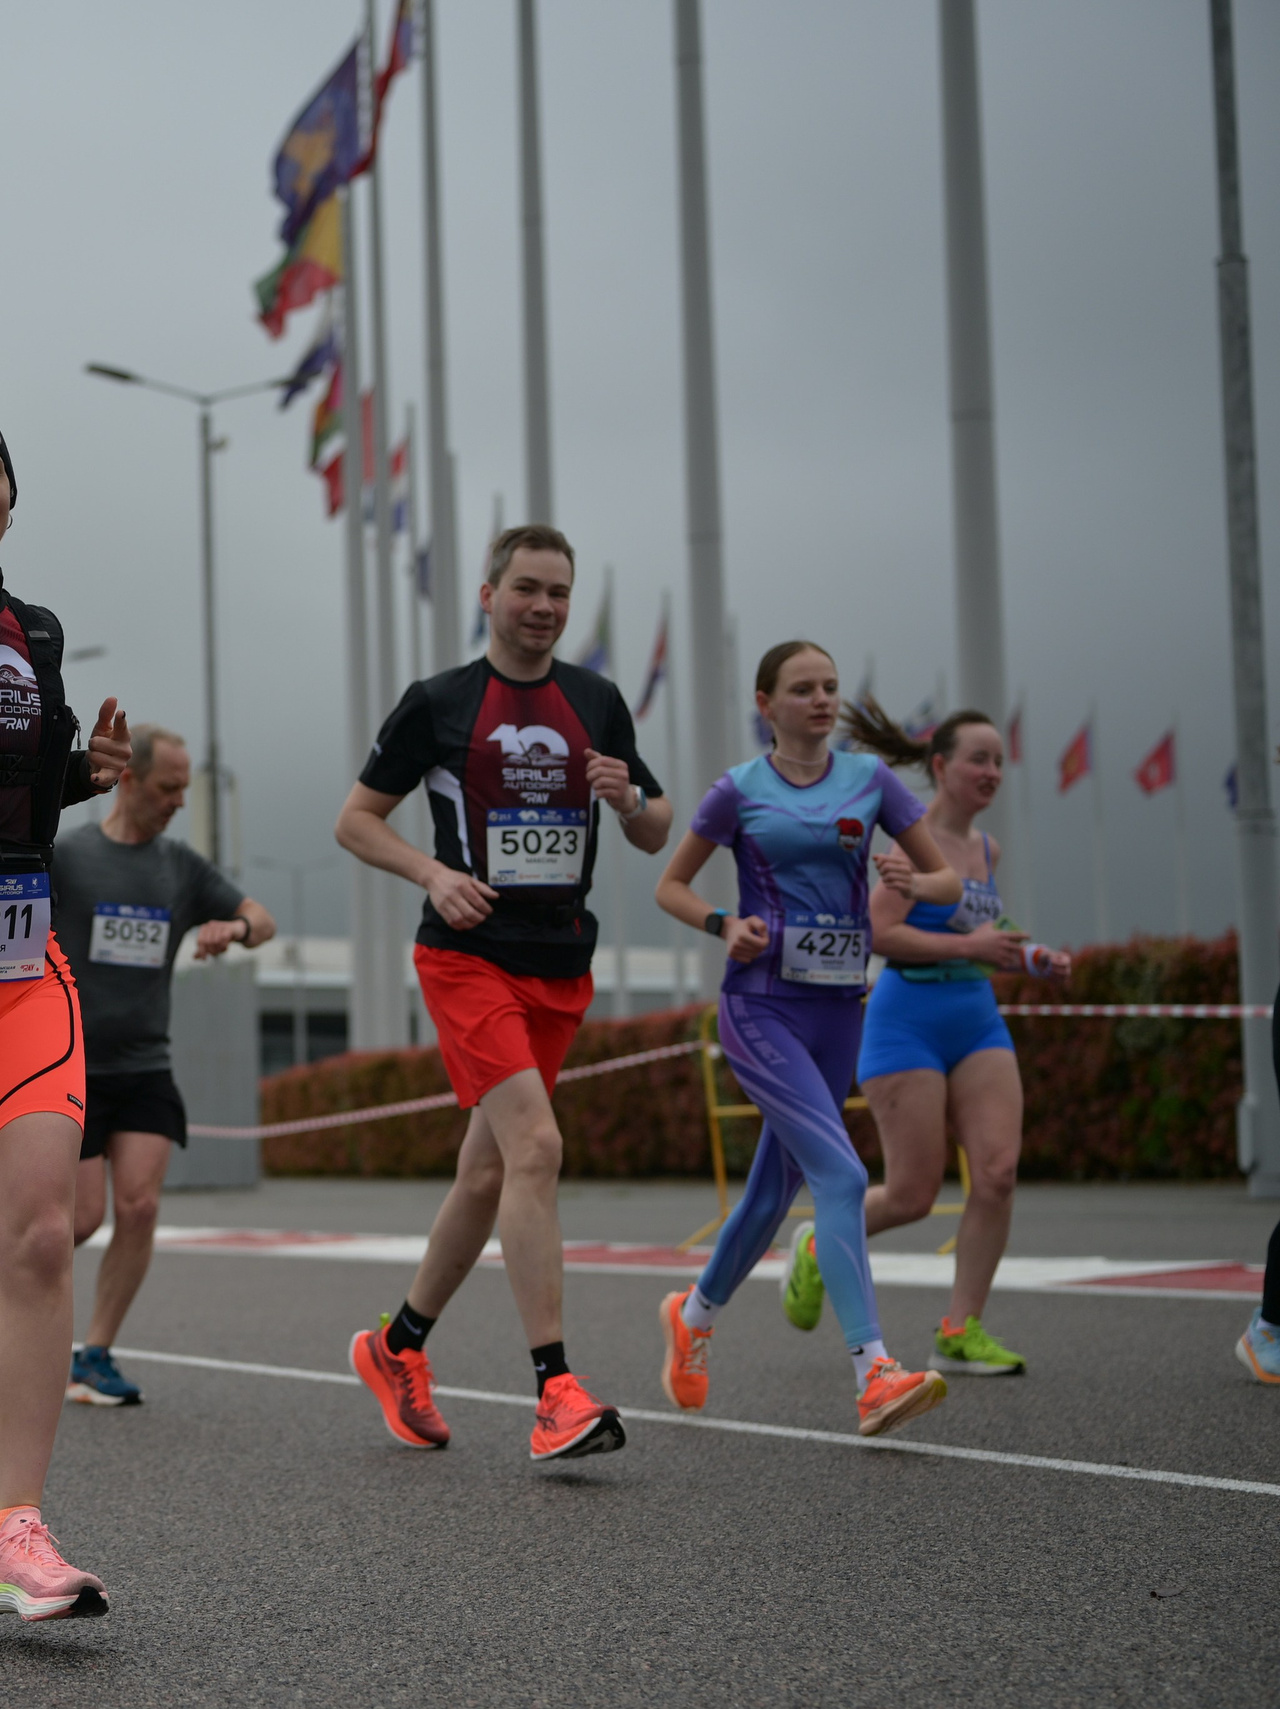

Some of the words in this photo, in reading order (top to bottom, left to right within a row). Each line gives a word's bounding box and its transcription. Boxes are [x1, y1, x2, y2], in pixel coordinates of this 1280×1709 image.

[486, 723, 570, 758] 10
[501, 767, 567, 782] SIRIUS
[519, 791, 550, 804] RAY
[501, 828, 578, 855] 5023
[104, 919, 162, 944] 5052
[796, 931, 862, 957] 4275
